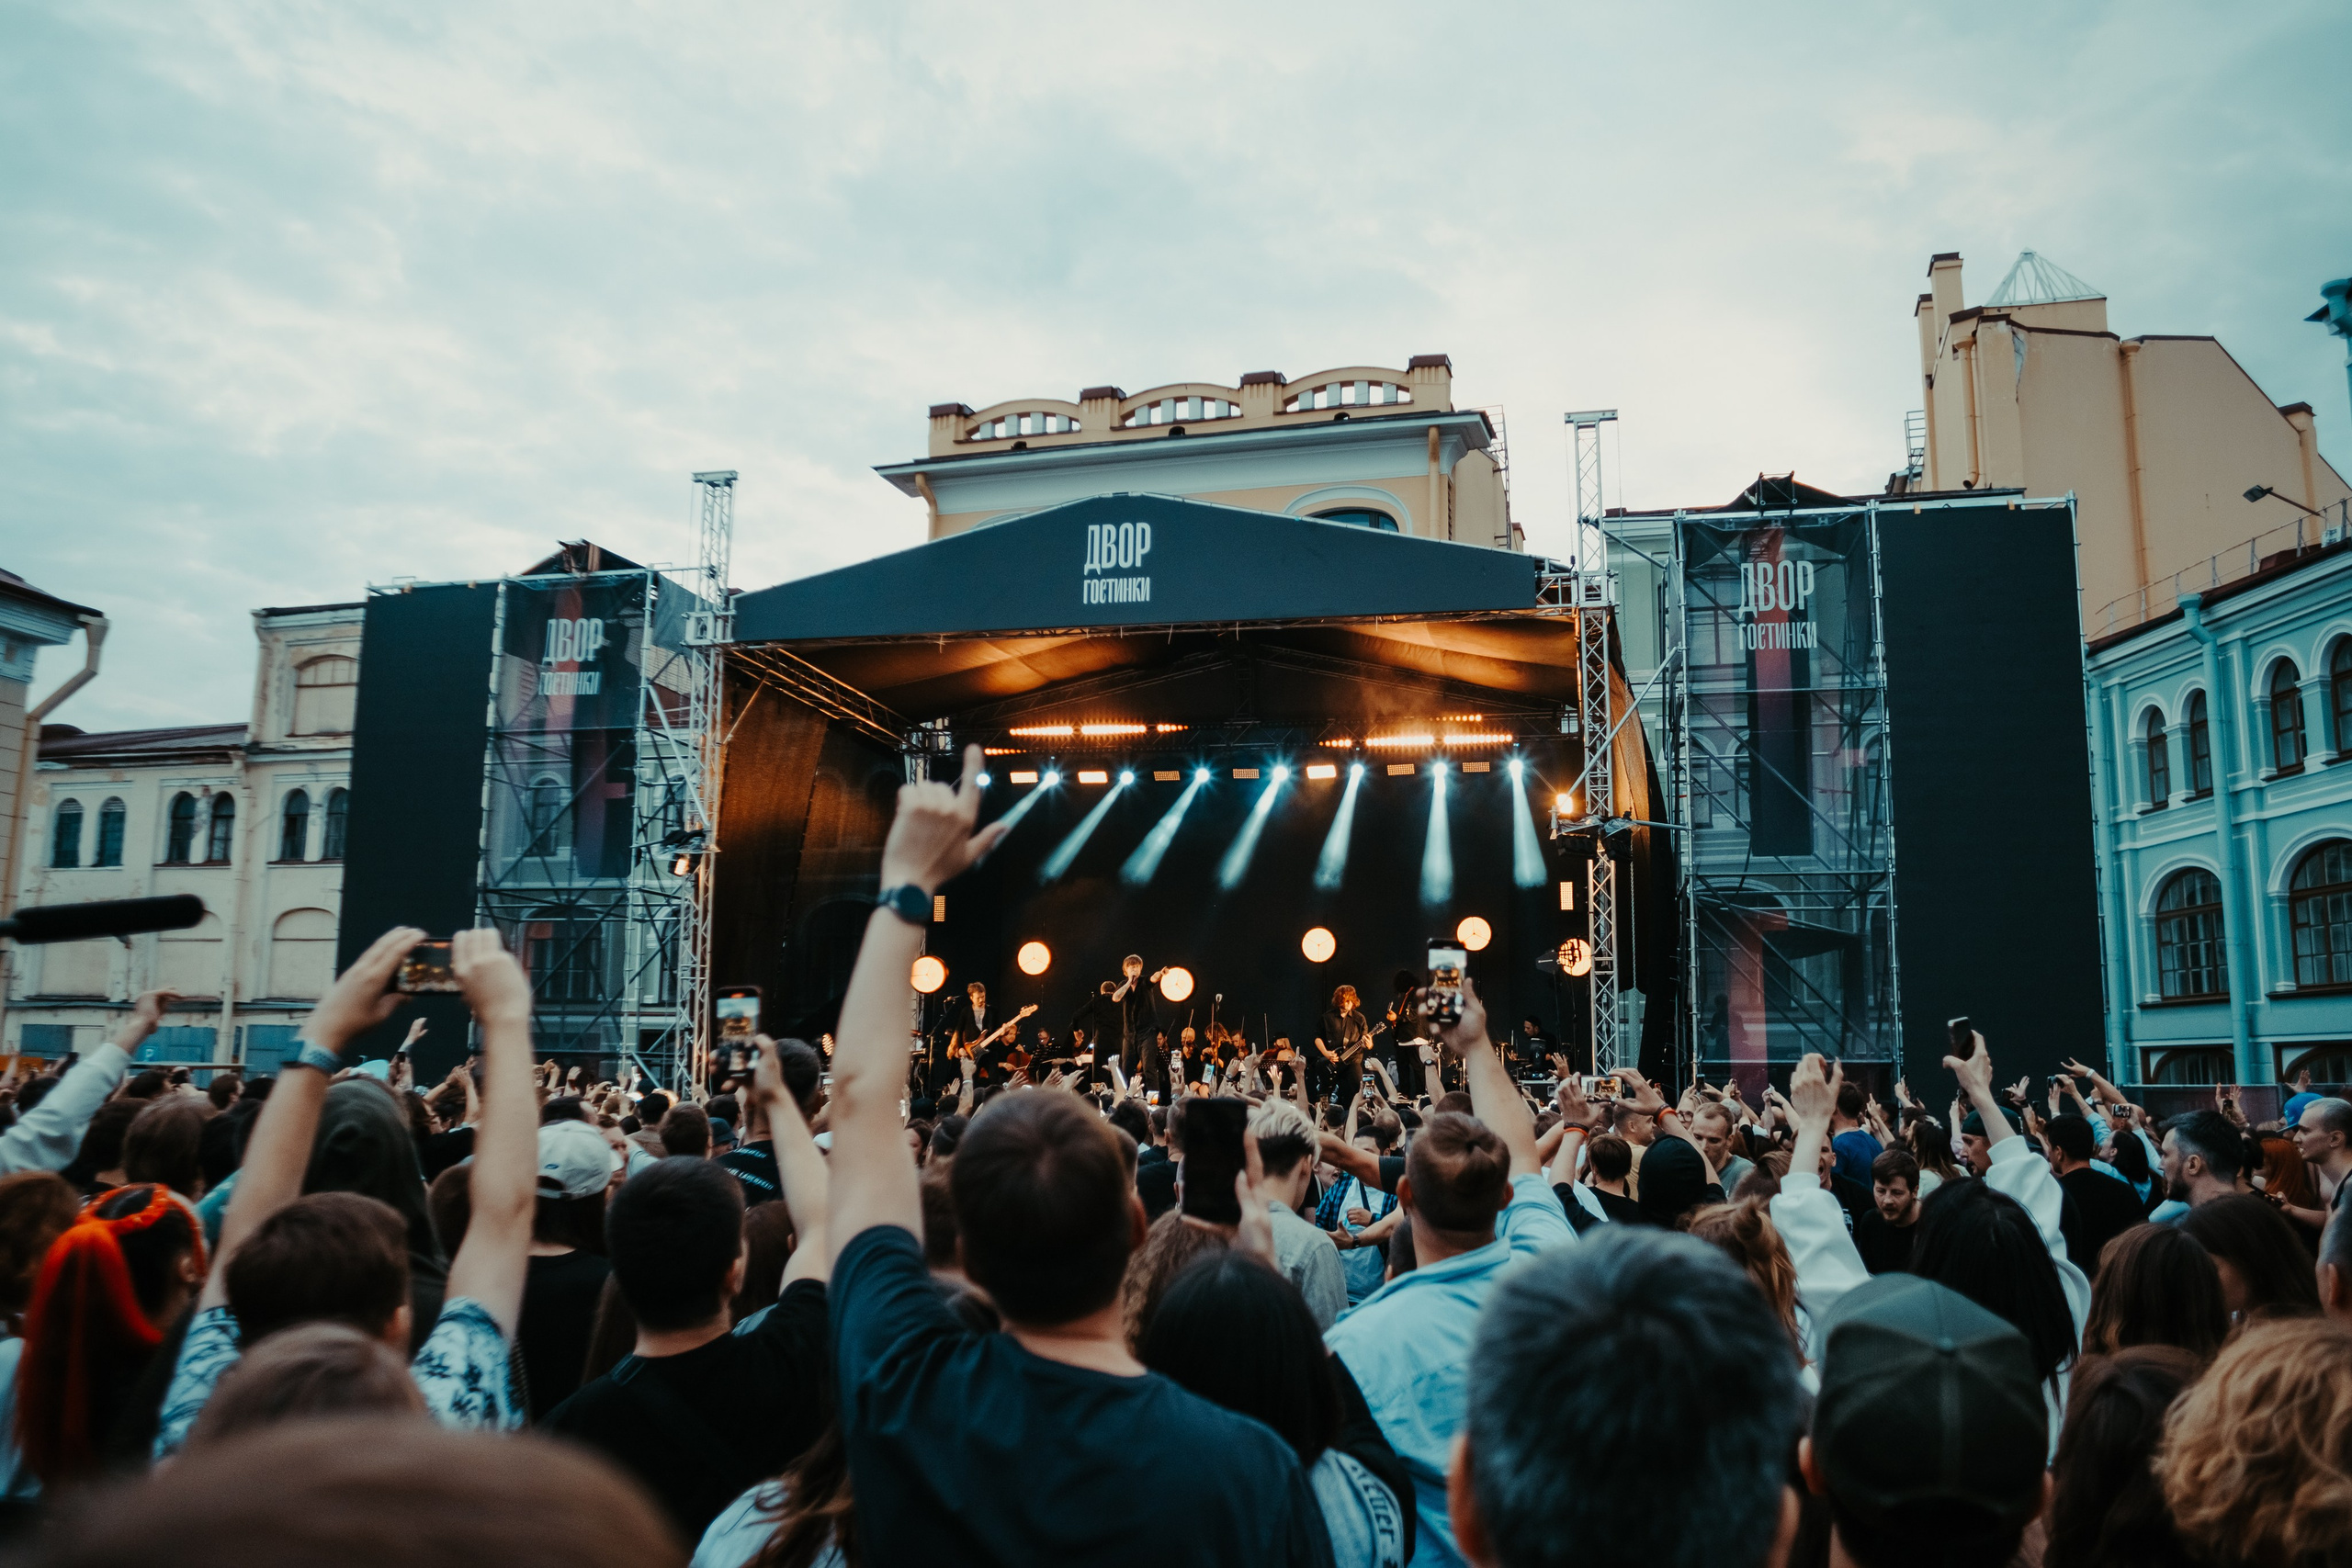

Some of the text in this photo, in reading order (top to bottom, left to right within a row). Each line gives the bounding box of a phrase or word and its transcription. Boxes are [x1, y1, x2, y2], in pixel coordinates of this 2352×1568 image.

[1083, 522, 1152, 576] ДВОР
[1082, 576, 1151, 604] ГОСТИНКИ
[1738, 559, 1815, 619] ДВОР
[541, 617, 604, 669] ДВОР
[1738, 621, 1818, 650] ГОСТИНКИ
